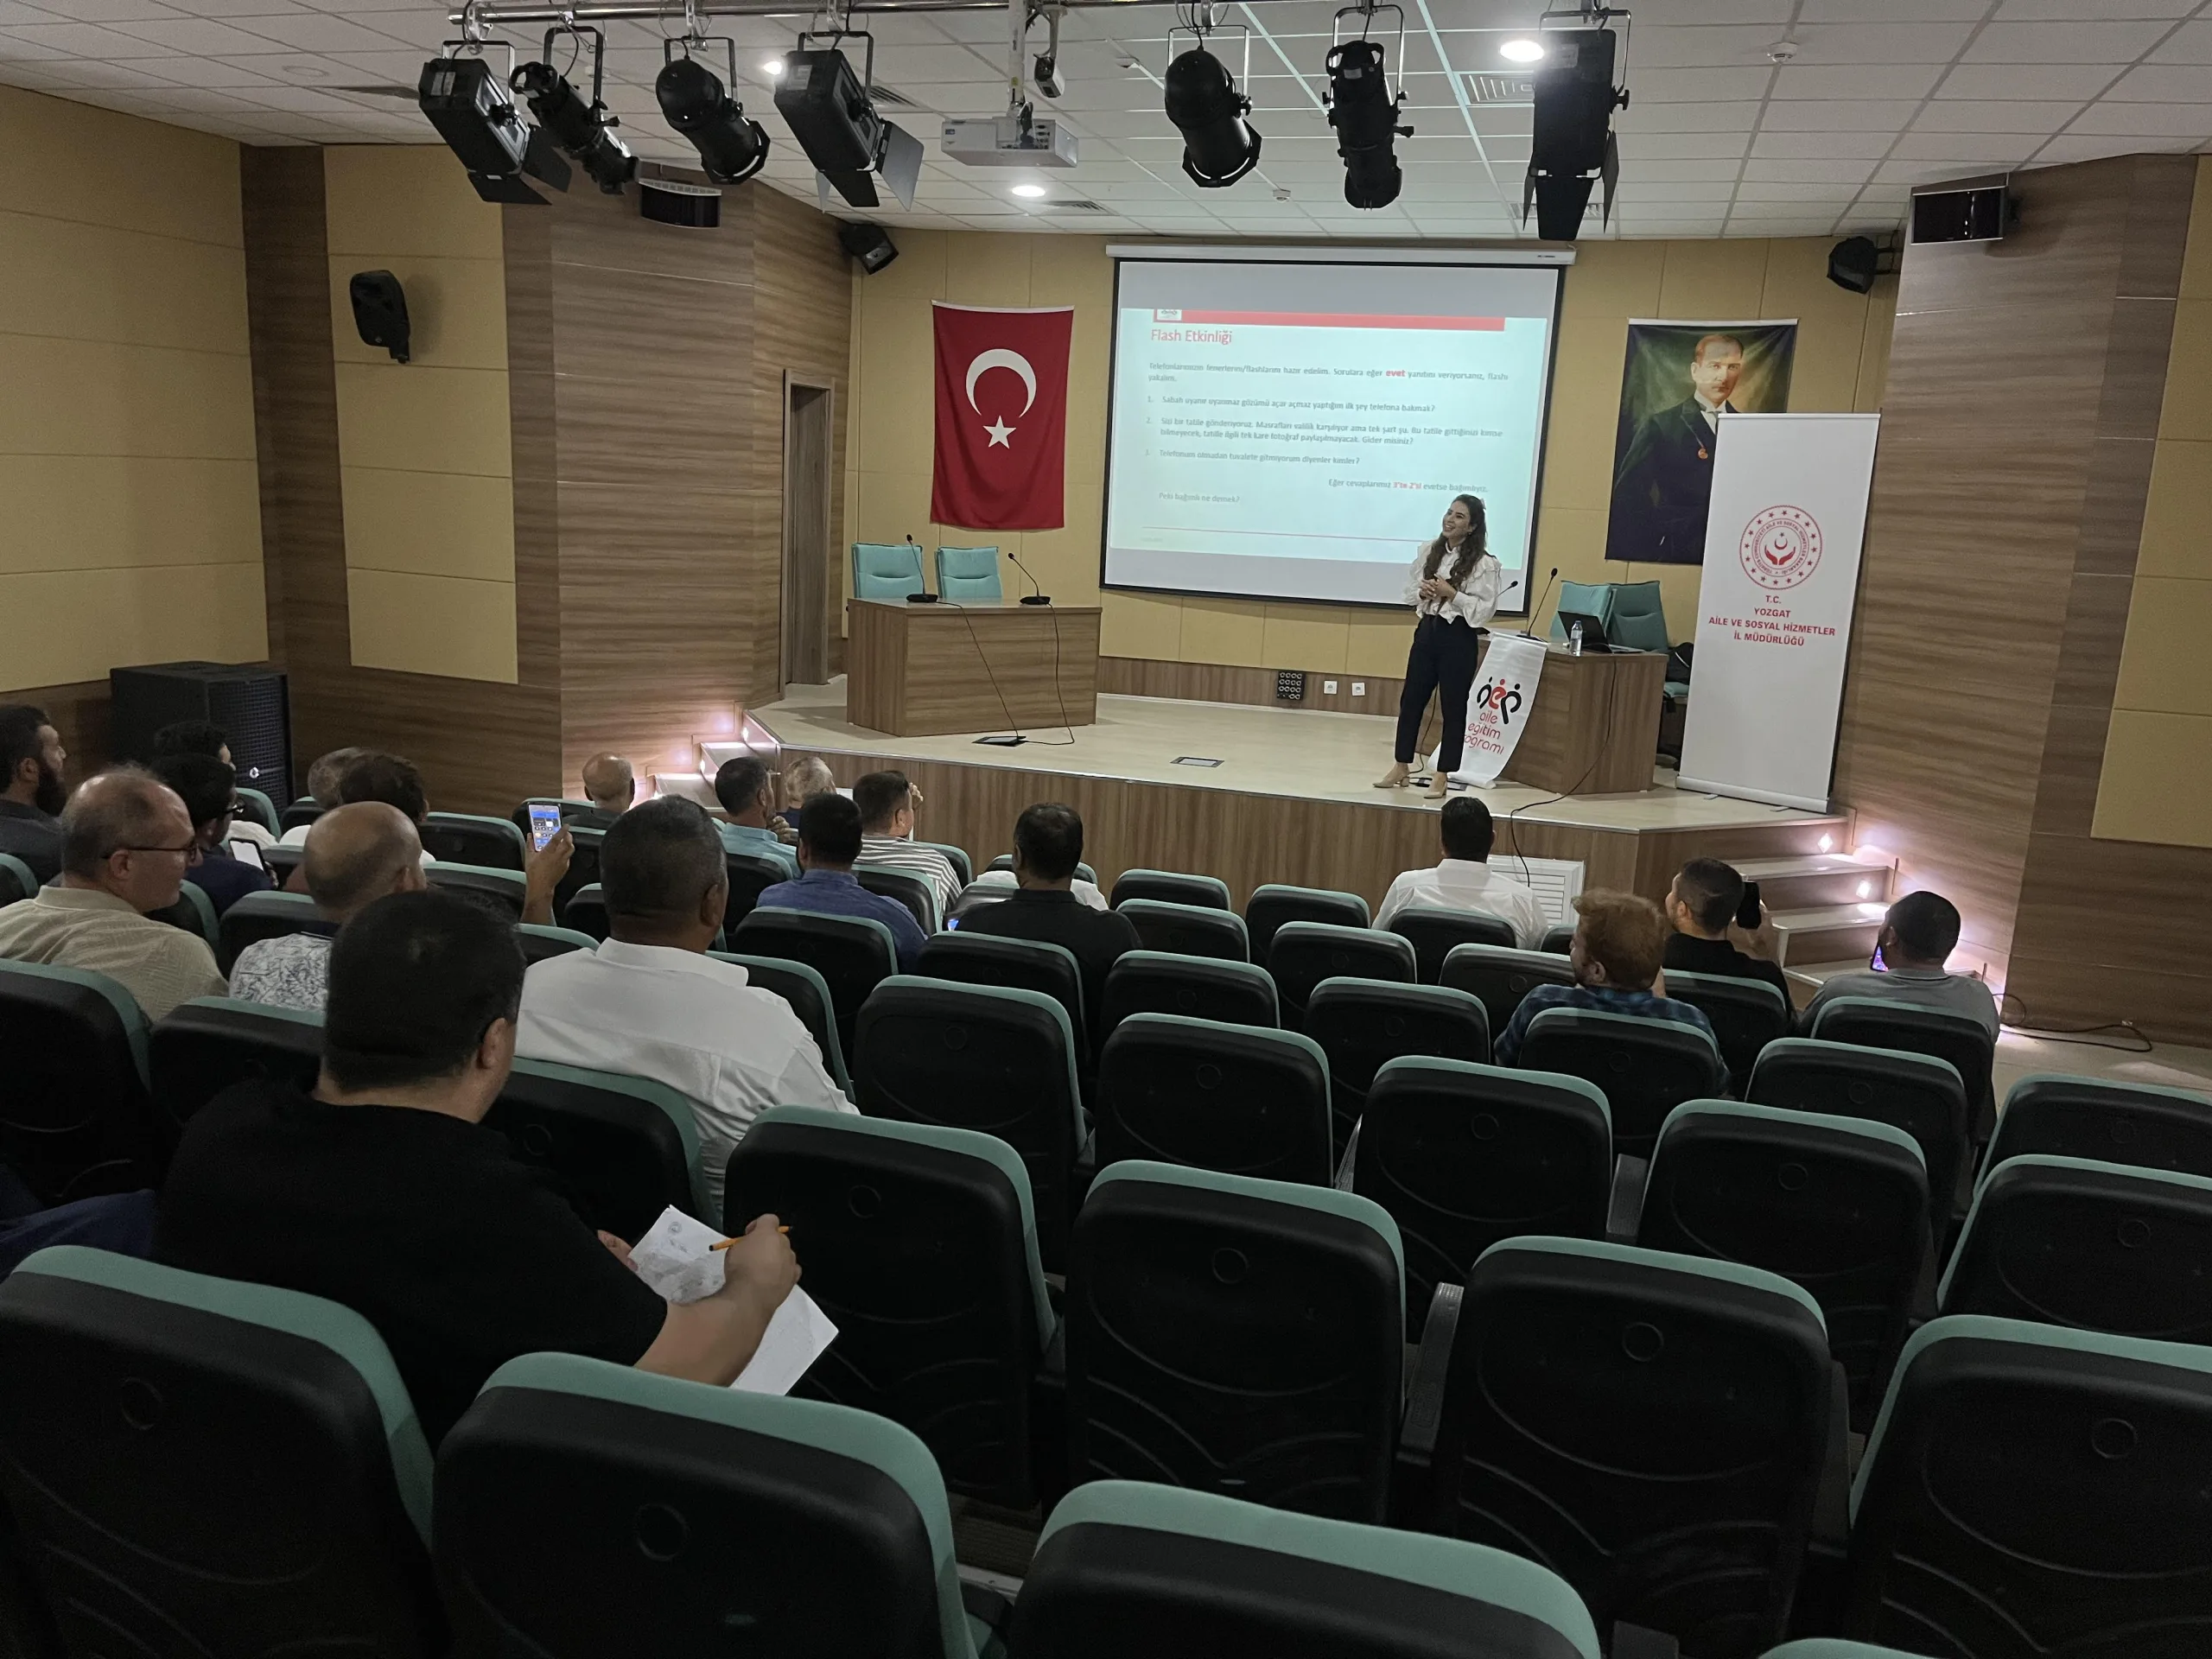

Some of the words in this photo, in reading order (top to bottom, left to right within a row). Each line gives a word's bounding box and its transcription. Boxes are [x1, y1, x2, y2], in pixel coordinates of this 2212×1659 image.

[1151, 329, 1181, 341] Flash
[1185, 330, 1232, 346] Etkinliği
[1366, 369, 1382, 378] eğer
[1242, 398, 1269, 408] gözümü
[1313, 401, 1344, 411] yaptığım
[1224, 431, 1239, 440] ilgili
[1271, 433, 1299, 442] fotoğraf
[1160, 449, 1196, 458] Telefonum
[1302, 456, 1331, 465] diyenler
[1329, 479, 1344, 487] Eğer
[1765, 595, 1782, 604] T.C.
[1754, 607, 1791, 618] YOZGAT
[1708, 615, 1728, 626] AİLE
[1745, 620, 1780, 631] SOSYAL
[1783, 621, 1835, 636] HİZMETLER
[1734, 630, 1741, 640] İL
[1745, 632, 1804, 646] MÜDÜRLÜĞÜ
[1479, 711, 1497, 724] aile
[1468, 721, 1501, 740] eğitim
